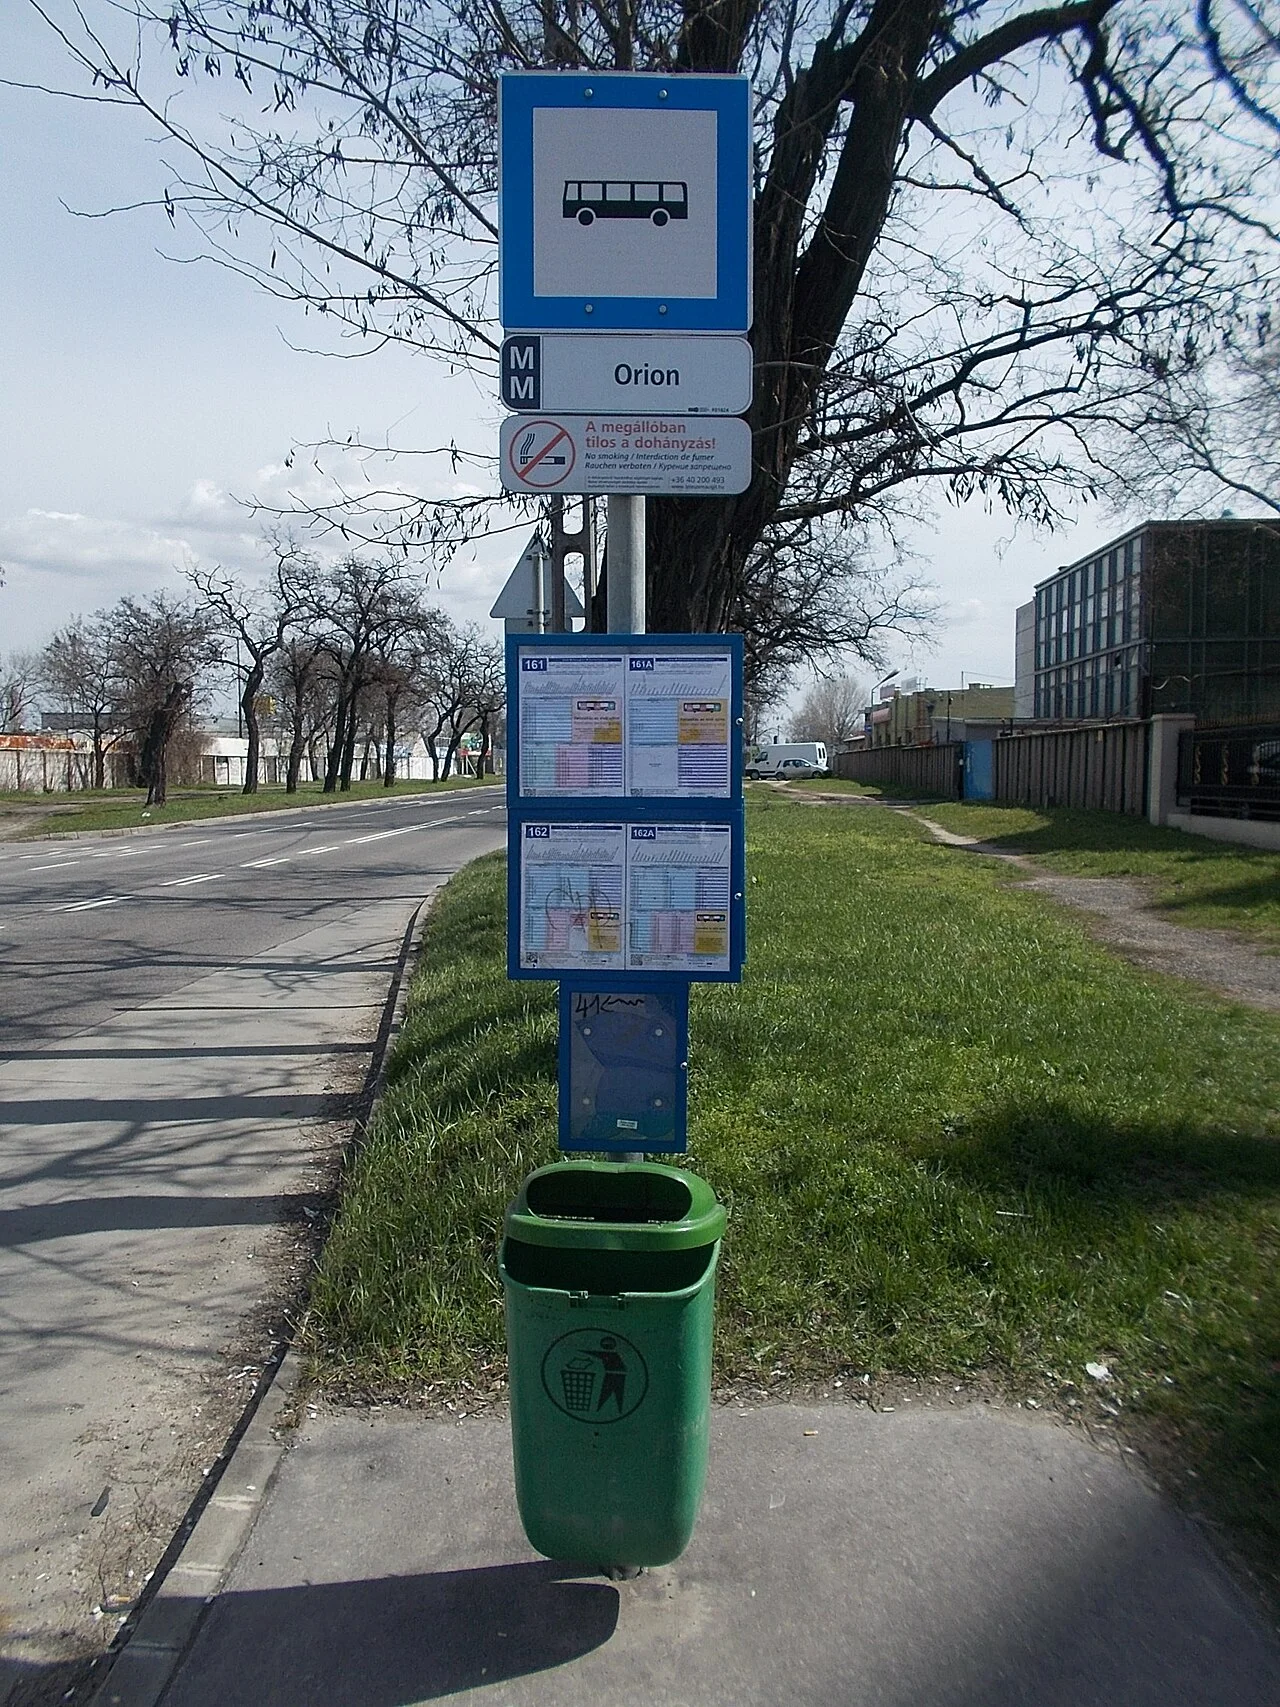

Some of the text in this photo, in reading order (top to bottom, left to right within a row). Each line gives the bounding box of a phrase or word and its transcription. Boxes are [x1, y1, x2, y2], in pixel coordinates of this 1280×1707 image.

[510, 346, 534, 370] M
[614, 362, 680, 386] Orion
[510, 376, 534, 400] M
[585, 420, 686, 437] A megállóban
[586, 435, 716, 453] tilos a dohányzás!
[585, 452, 596, 460] No
[598, 452, 629, 462] smoking
[636, 452, 679, 460] Interdiction
[691, 452, 715, 462] fumer
[585, 462, 617, 470] Rauchen
[619, 462, 652, 470] verboten
[686, 476, 696, 484] 40
[525, 660, 544, 670] 161
[631, 660, 653, 669] 161A
[528, 826, 548, 837] 162
[633, 829, 655, 838] 162A
